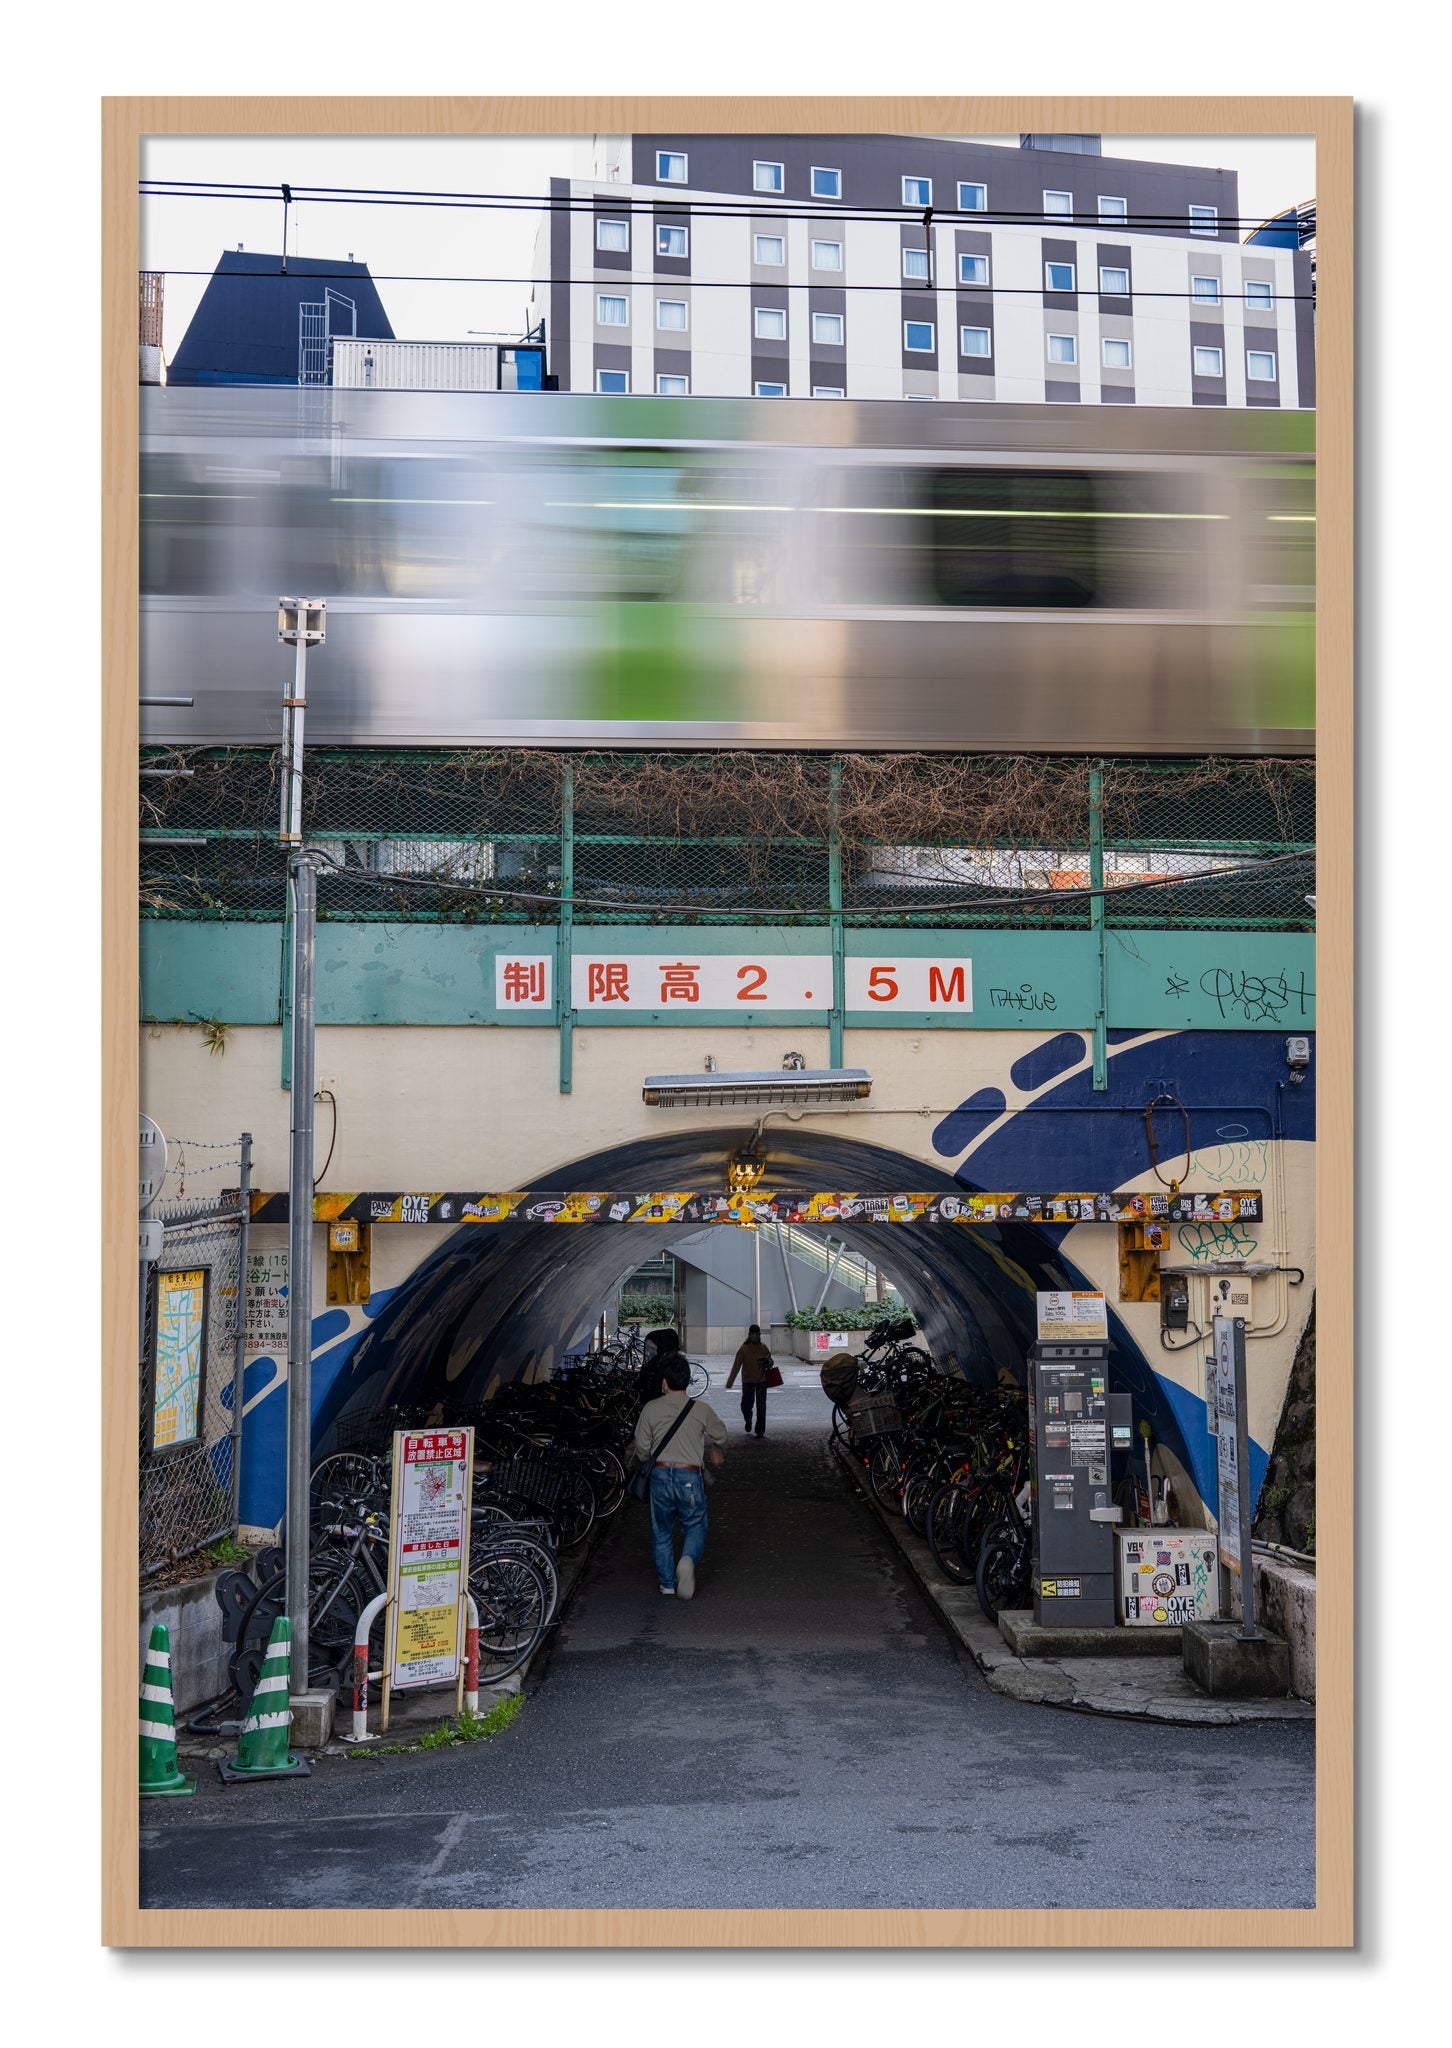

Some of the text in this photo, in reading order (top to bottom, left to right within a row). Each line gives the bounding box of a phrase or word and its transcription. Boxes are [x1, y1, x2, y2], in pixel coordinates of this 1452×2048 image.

[402, 1195, 430, 1209] OYE
[1240, 1198, 1257, 1207] OYE
[401, 1209, 429, 1223] RUNS
[1240, 1206, 1257, 1216] RUNS
[408, 1436, 462, 1449] 自転車等
[408, 1447, 462, 1461] 放置禁止区域
[1168, 1597, 1195, 1610] OYE
[1168, 1610, 1195, 1625] RUNS
